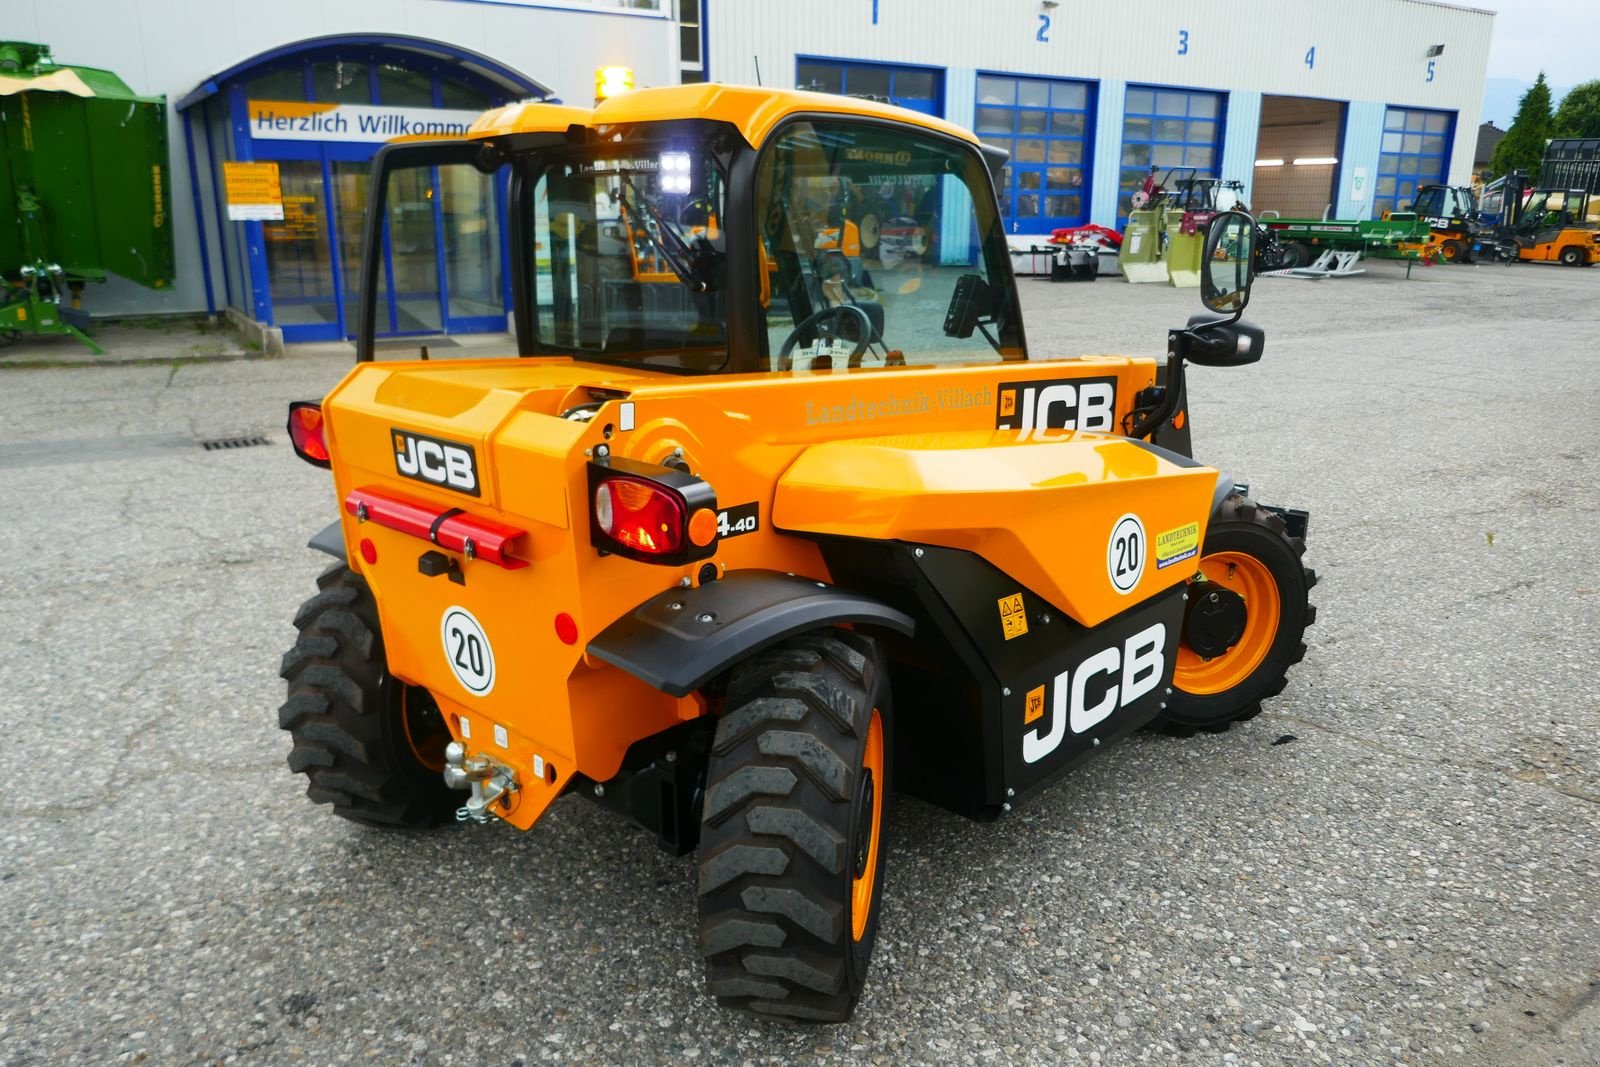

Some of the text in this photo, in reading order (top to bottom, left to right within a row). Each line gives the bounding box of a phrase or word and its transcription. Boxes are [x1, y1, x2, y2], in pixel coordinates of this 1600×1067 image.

[1036, 14, 1051, 43] 2
[1177, 30, 1189, 56] 3
[1304, 46, 1316, 70] 4
[1425, 61, 1436, 83] 5
[257, 110, 473, 137] Herzlich Willkomm
[999, 383, 1114, 432] JCB
[397, 437, 476, 490] JCB
[1157, 525, 1197, 547] LANDTECHNIK
[1116, 532, 1138, 577] 20
[452, 627, 485, 677] 20
[1022, 622, 1166, 764] JCB
[1029, 696, 1042, 714] JCB
